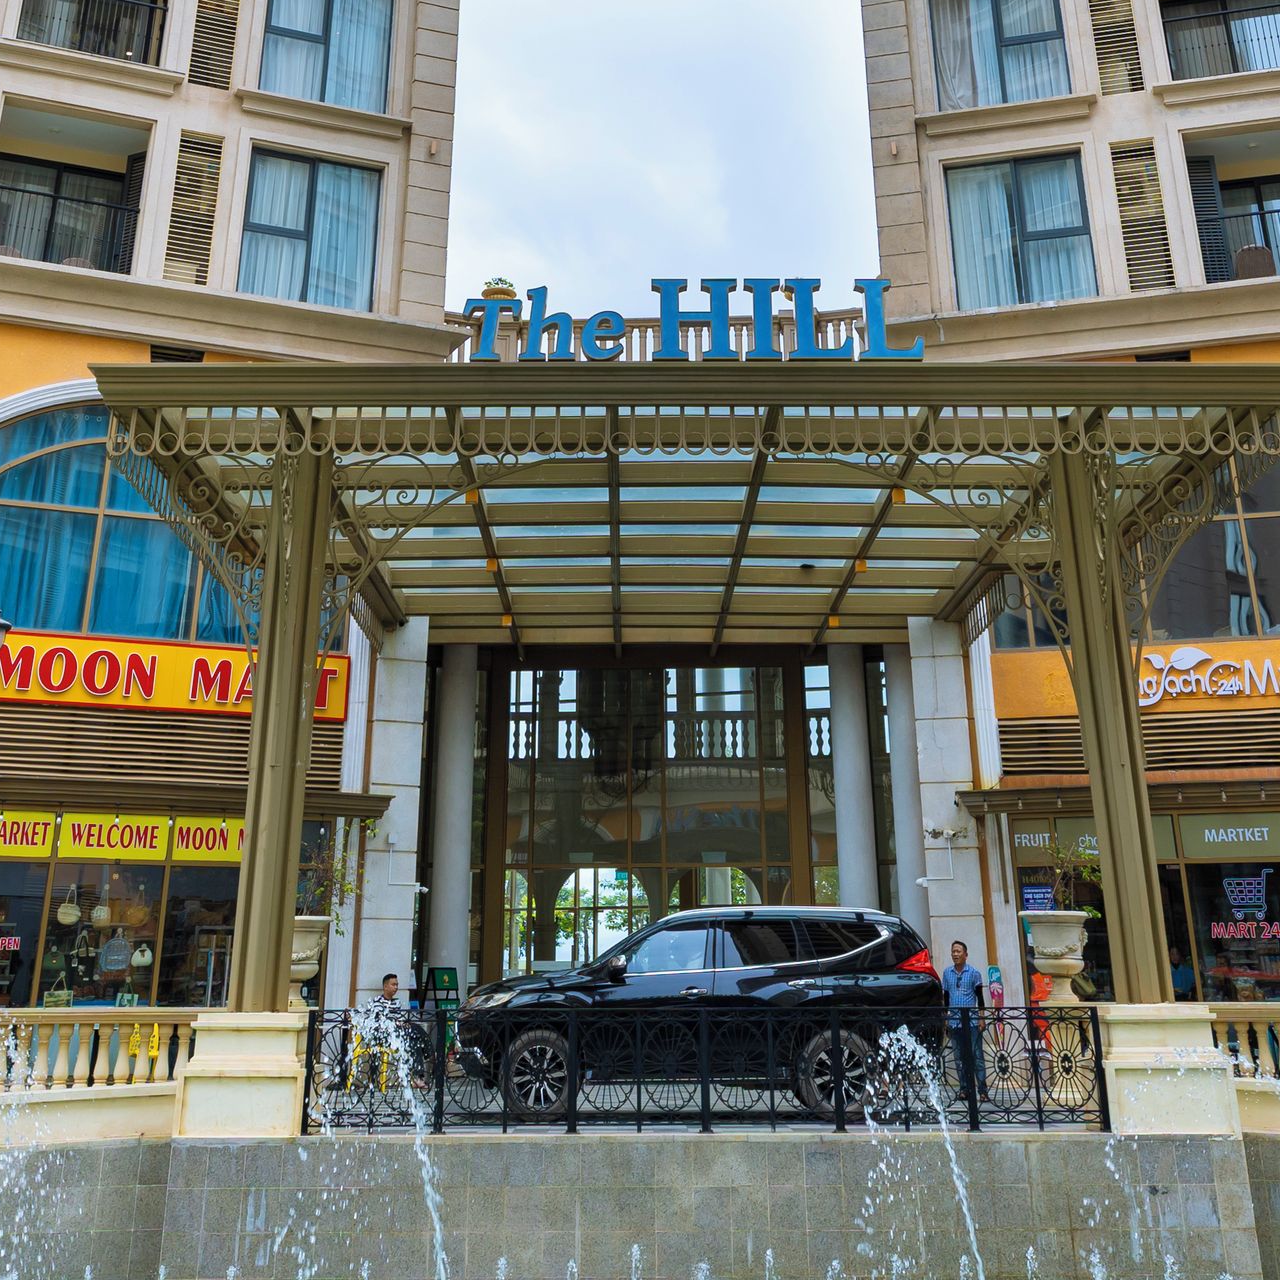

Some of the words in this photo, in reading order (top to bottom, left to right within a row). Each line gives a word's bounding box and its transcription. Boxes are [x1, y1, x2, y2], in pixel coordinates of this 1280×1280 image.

[464, 286, 625, 361] The
[651, 278, 924, 361] HILL
[188, 656, 338, 709] MAT
[71, 822, 160, 849] WELCOME
[176, 826, 229, 851] MOON
[1014, 833, 1051, 847] FRUIT
[1204, 827, 1269, 843] MARTKET
[1211, 922, 1256, 938] MART
